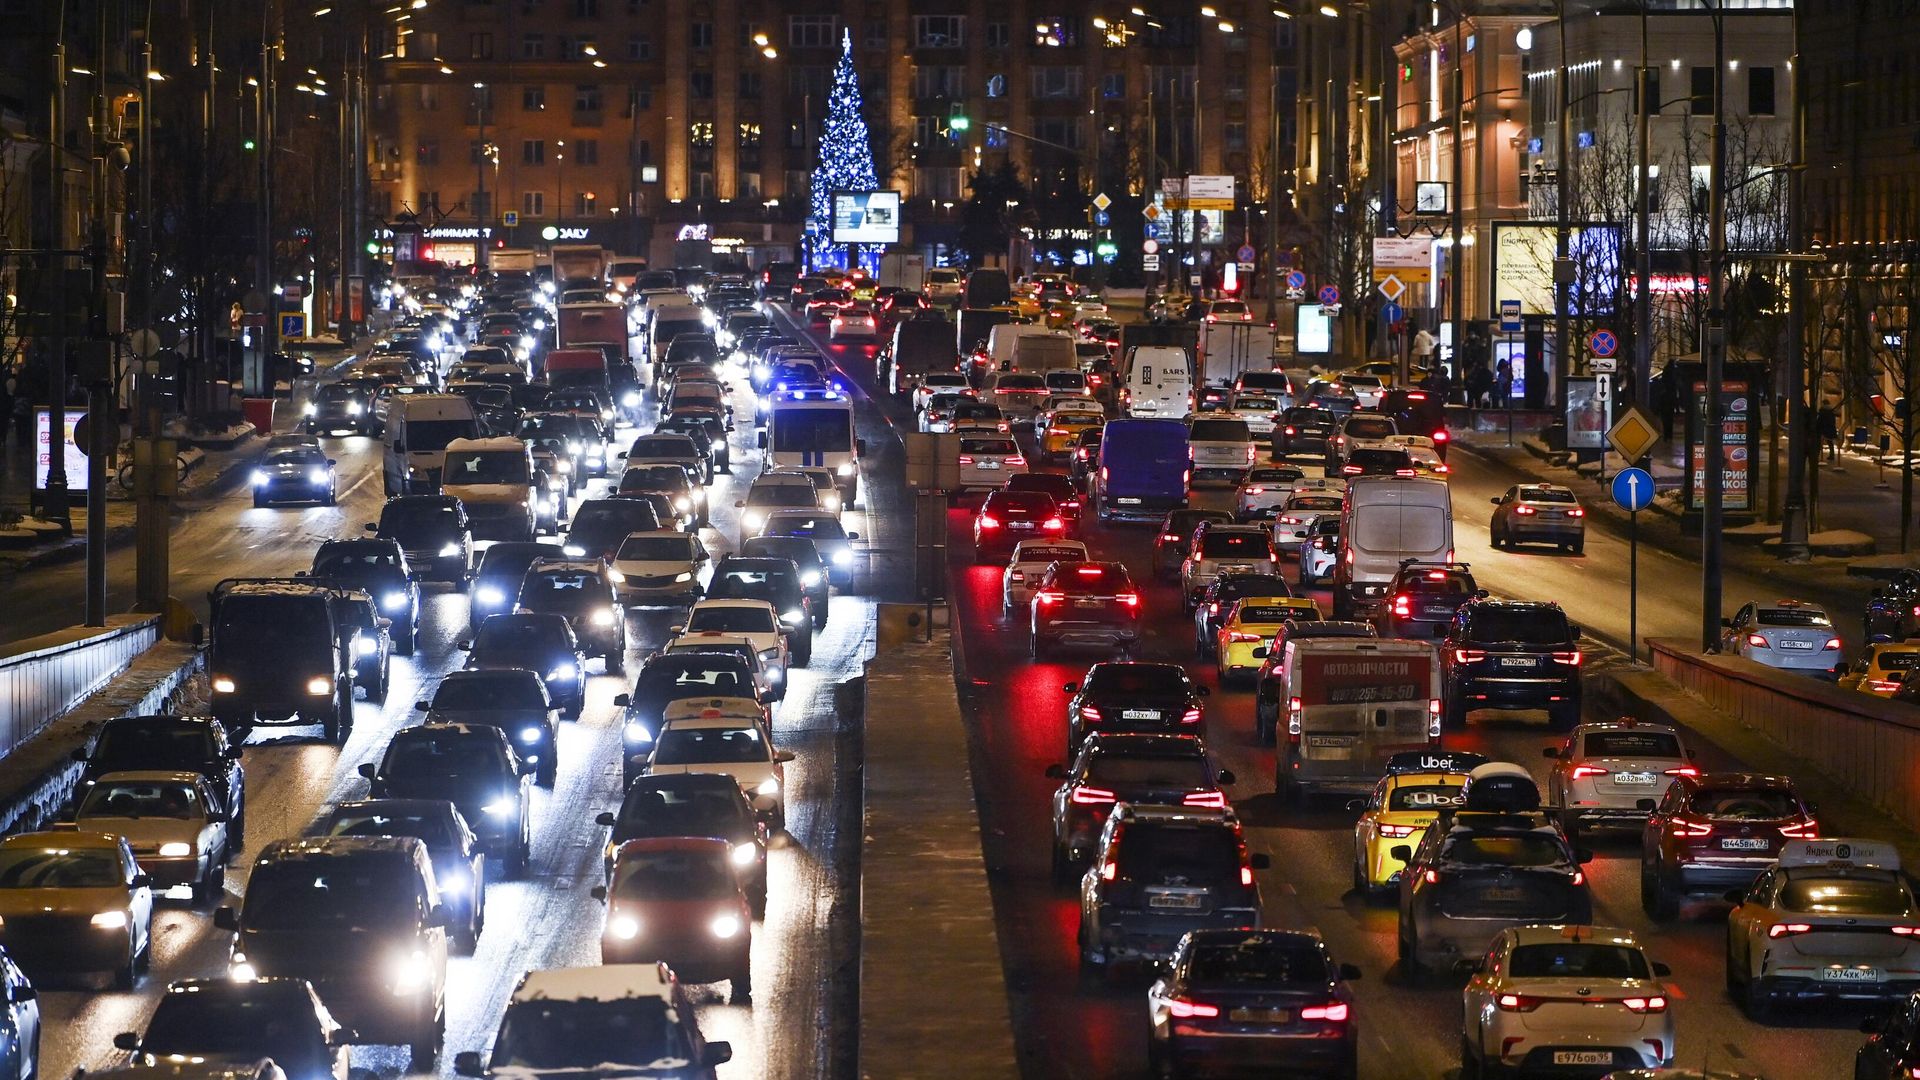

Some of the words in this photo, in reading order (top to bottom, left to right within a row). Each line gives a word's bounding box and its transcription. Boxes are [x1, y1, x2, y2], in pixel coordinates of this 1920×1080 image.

[423, 228, 491, 238] МИНИМАРКТ
[1323, 662, 1409, 676] АВТОЗАПЧАСТИ
[1420, 756, 1454, 769] Uber
[1413, 793, 1464, 805] Ube
[1805, 845, 1834, 857] Яндекс
[1852, 846, 1875, 858] Такси
